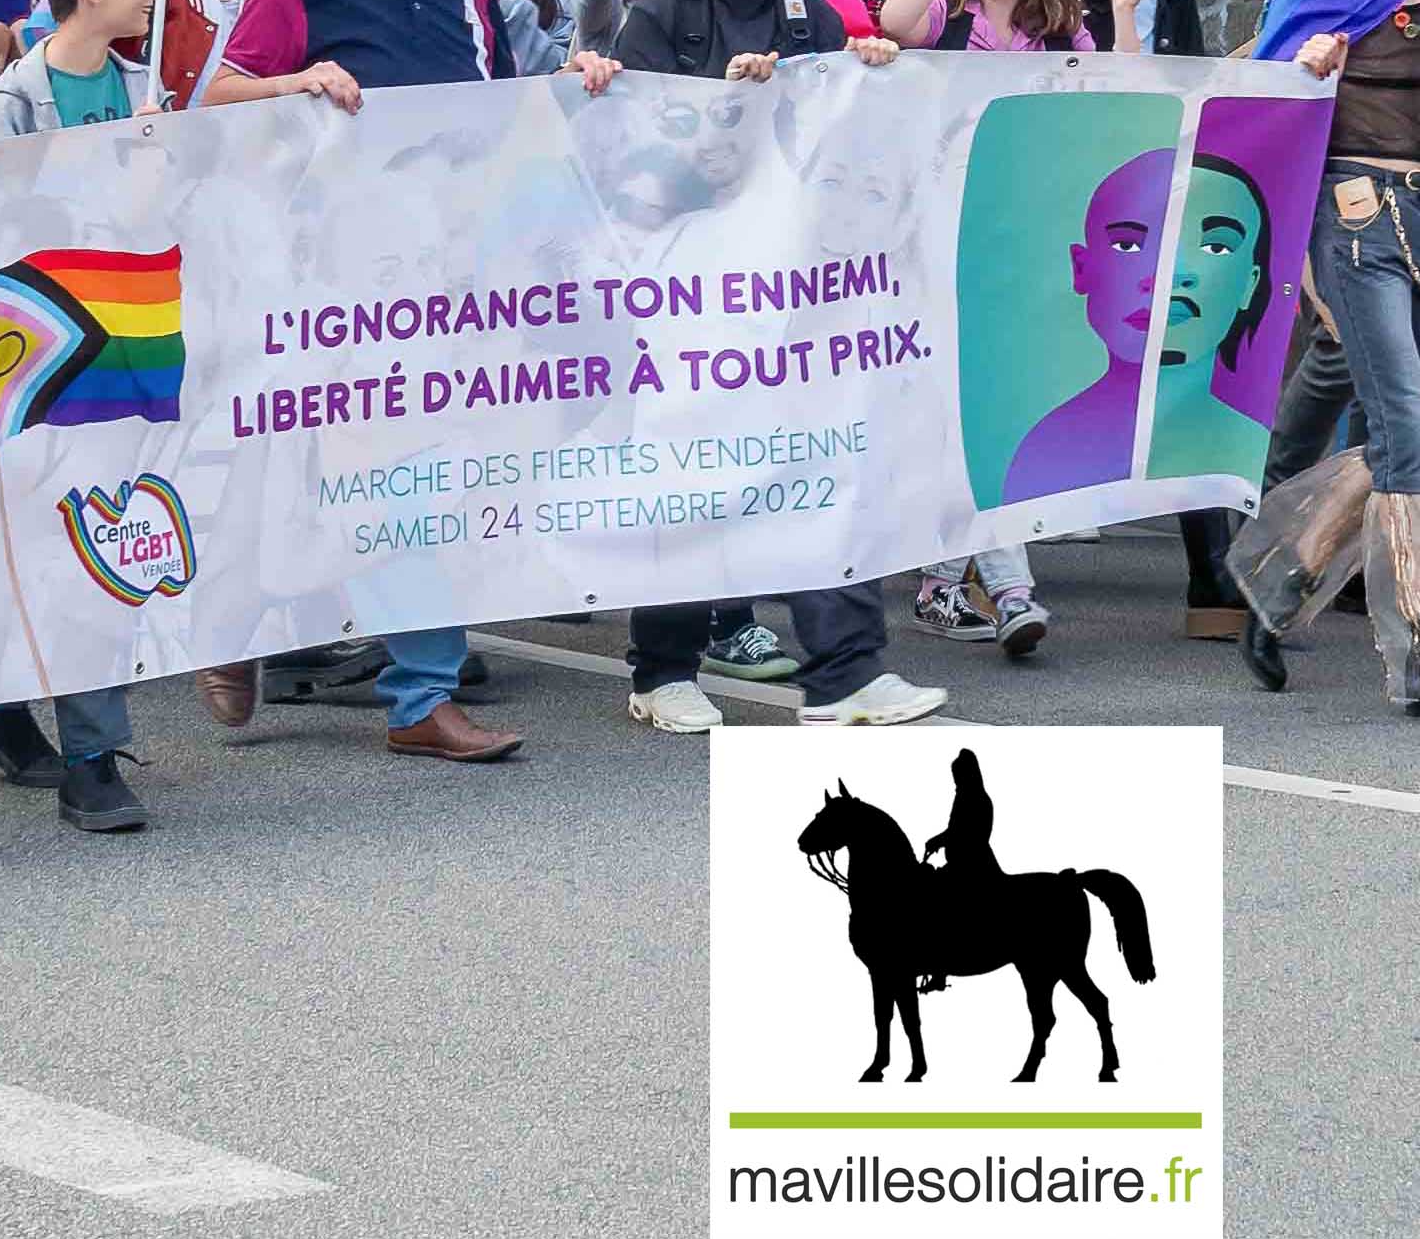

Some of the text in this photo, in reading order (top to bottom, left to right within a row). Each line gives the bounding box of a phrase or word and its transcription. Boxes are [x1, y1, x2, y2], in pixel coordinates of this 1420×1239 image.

[265, 252, 901, 355] L'IGNORANCE TON ENNEMI,
[232, 318, 933, 438] LIBERTÉ D'AIMER À TOUT PRIX.
[318, 421, 869, 507] MARCHE DES FIERTÉS VENDÉENNE
[94, 519, 151, 545] Centre
[119, 530, 174, 567] LGBT
[354, 476, 837, 554] SAMEDI 24 SEPTEMBRE 2022
